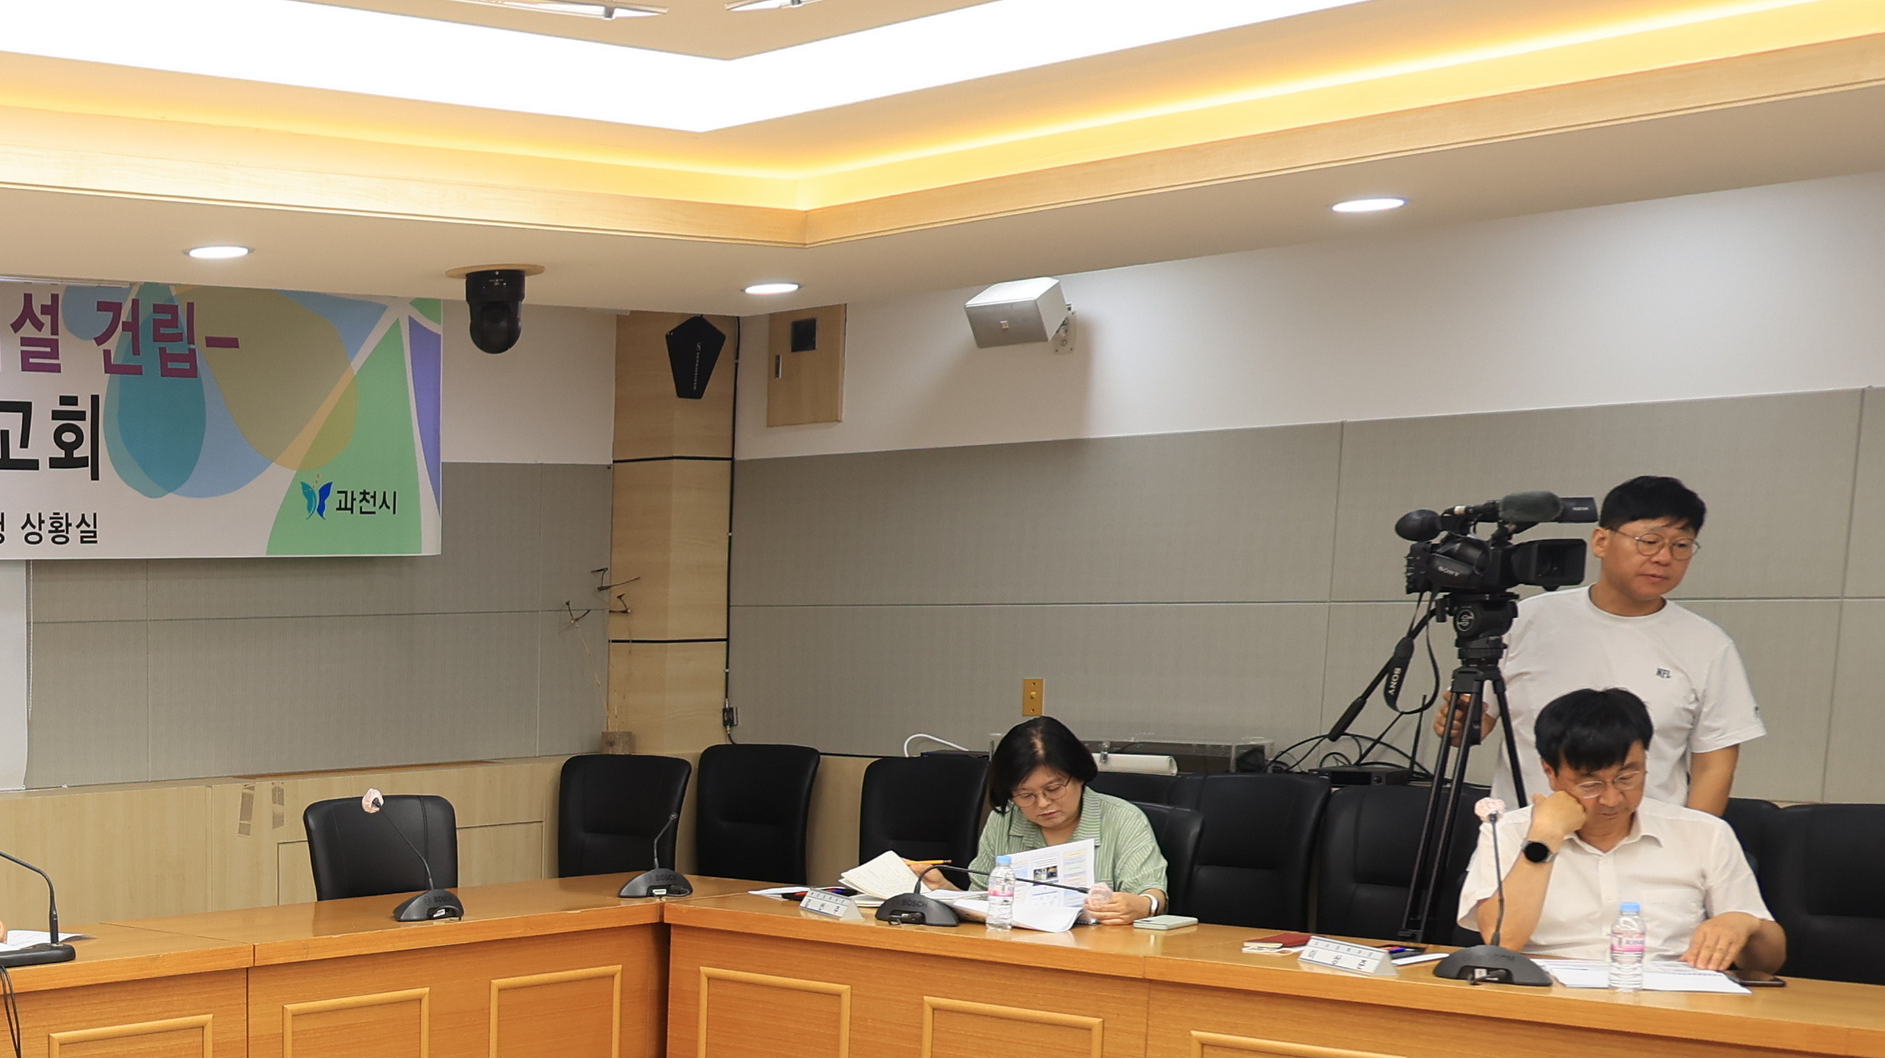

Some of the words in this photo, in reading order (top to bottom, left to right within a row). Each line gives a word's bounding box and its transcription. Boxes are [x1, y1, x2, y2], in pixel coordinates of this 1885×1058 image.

[335, 489, 397, 515] 과천시
[20, 512, 99, 546] 상황실
[1437, 566, 1460, 577] SONY
[1388, 667, 1402, 696] SONY
[1656, 667, 1671, 679] NFL
